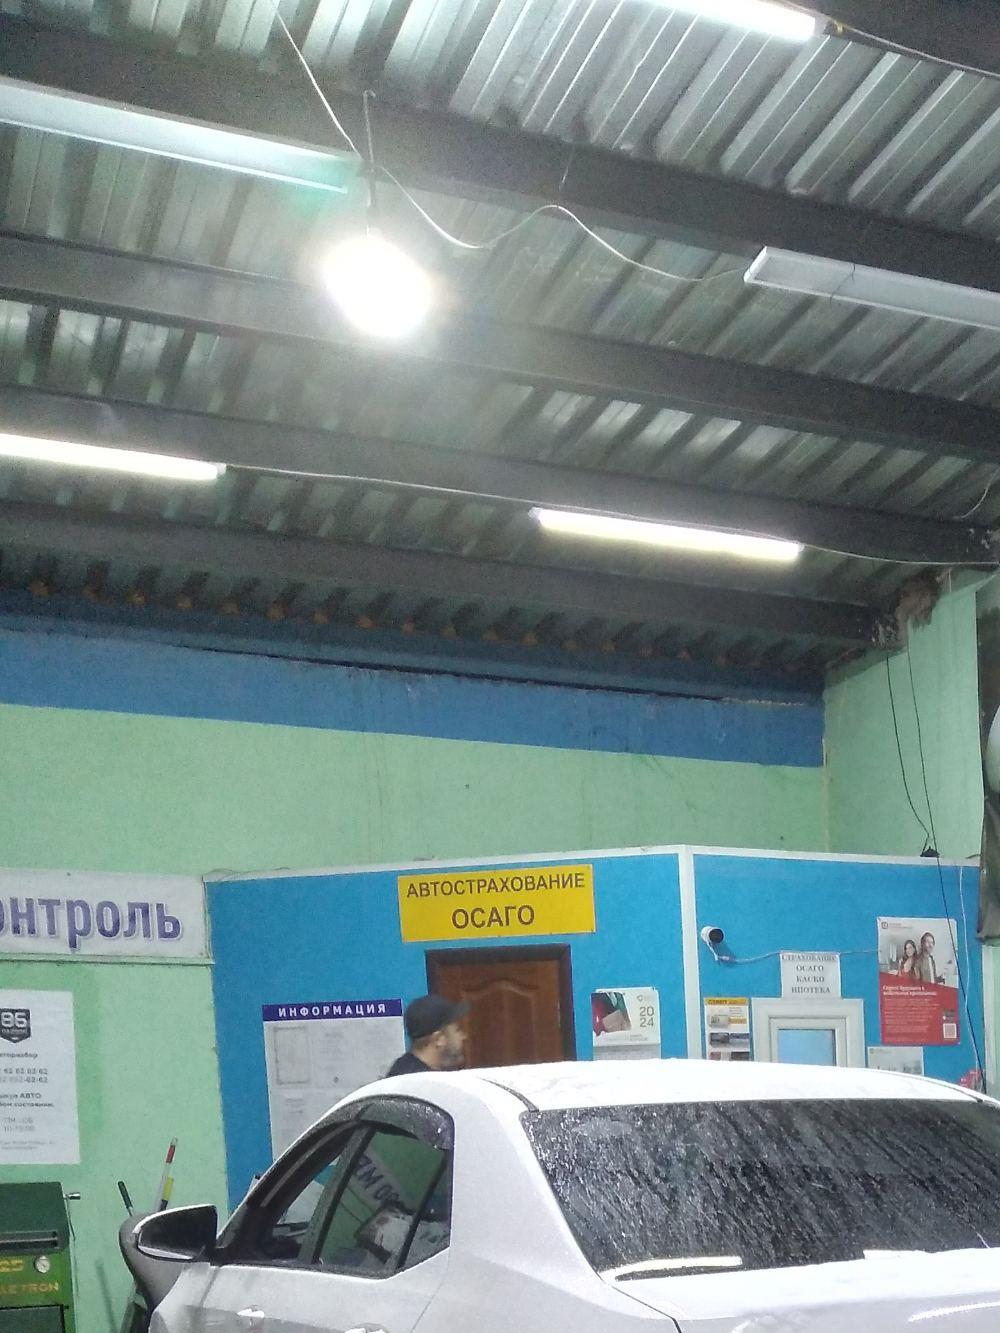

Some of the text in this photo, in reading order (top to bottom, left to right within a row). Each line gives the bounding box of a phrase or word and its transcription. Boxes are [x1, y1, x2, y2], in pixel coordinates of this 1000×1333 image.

[407, 872, 585, 898] АВТОСТРАХОВАНИЕ
[0, 897, 182, 949] нтроль
[451, 905, 535, 929] ОСАГО
[796, 975, 825, 983] КАСКО
[278, 1003, 387, 1018] ИНФОРМАЦИЯ
[640, 1006, 654, 1017] 20
[640, 1017, 654, 1028] 24
